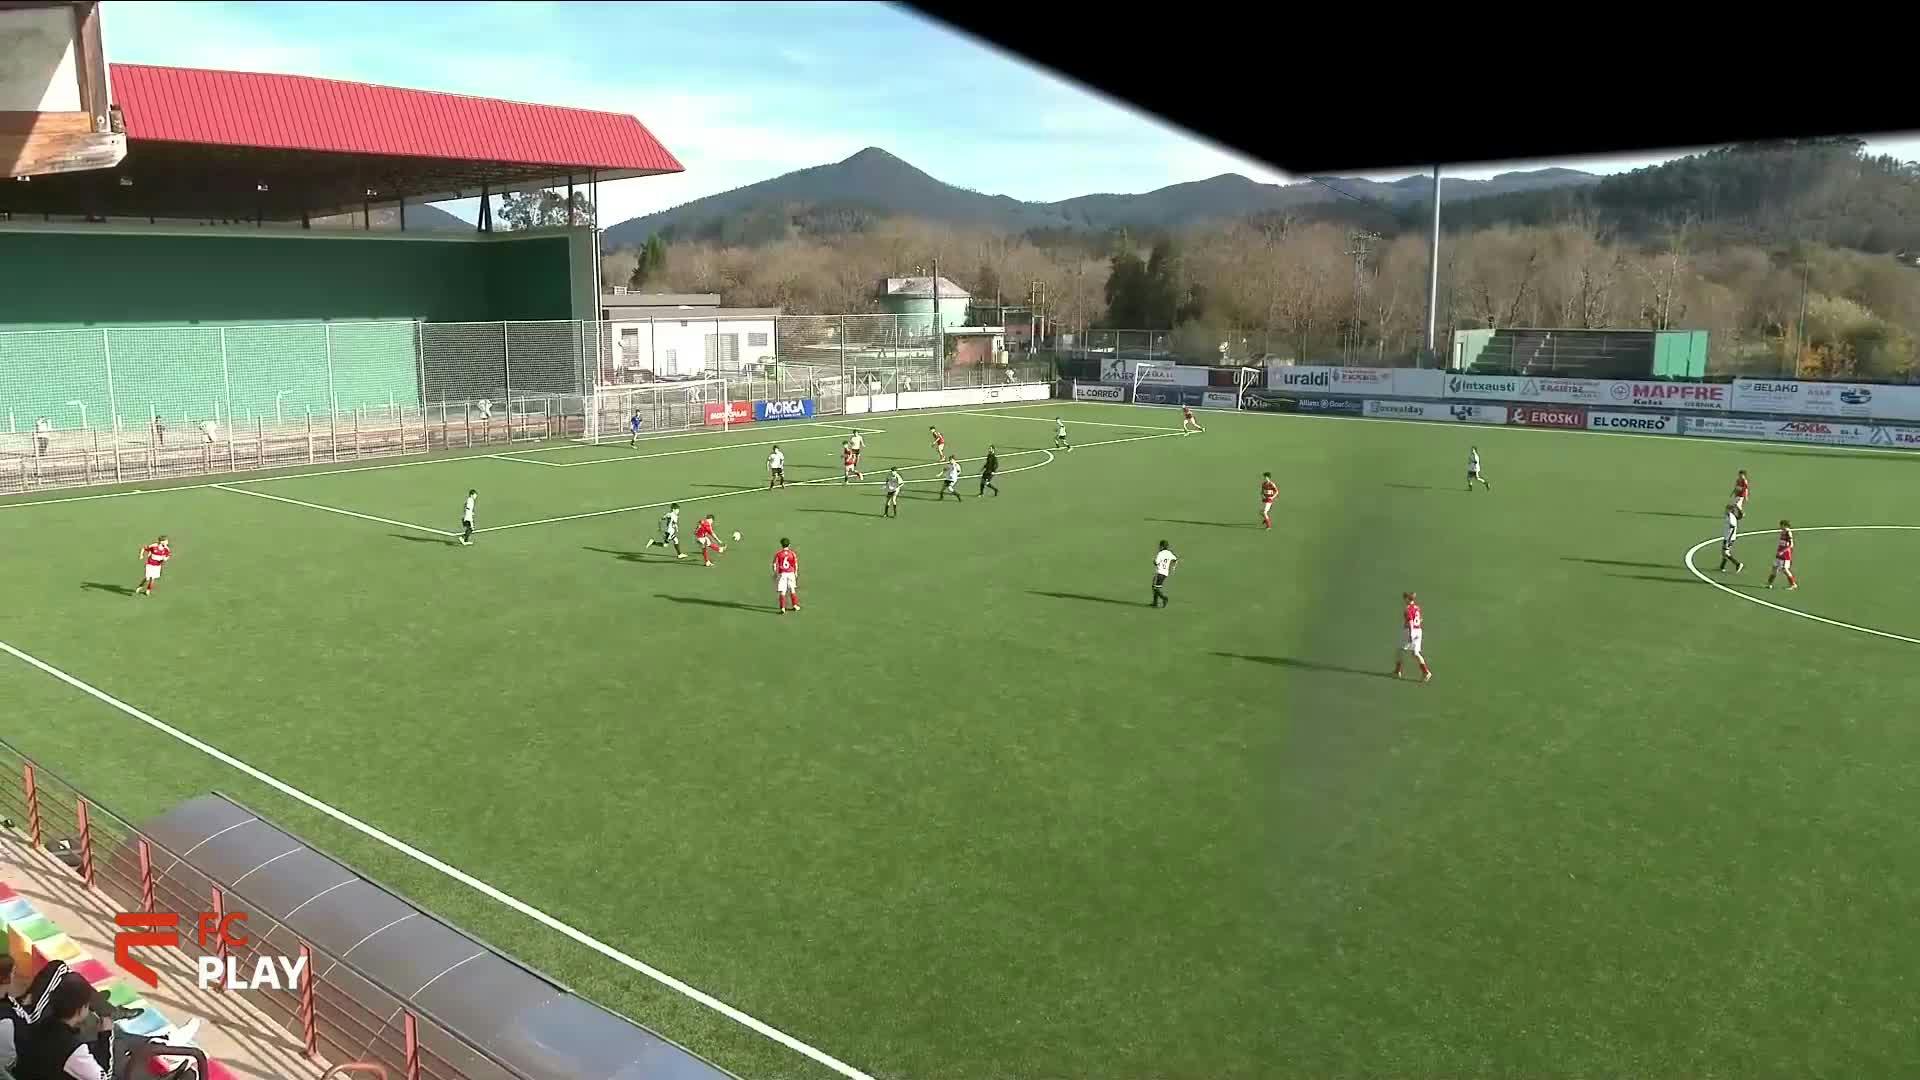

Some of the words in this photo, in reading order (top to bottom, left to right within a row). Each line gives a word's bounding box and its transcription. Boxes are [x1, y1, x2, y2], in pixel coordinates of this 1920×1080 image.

[1284, 370, 1329, 387] uraldi
[1462, 380, 1516, 393] Intxausti
[1632, 384, 1725, 401] MAPFRE
[1753, 383, 1798, 393] BELAKO
[1086, 390, 1119, 398] CORREO
[765, 401, 805, 417] MORGA
[1531, 411, 1579, 425] EROSKI
[1594, 417, 1607, 426] EL
[1611, 417, 1665, 430] CORREO
[783, 556, 790, 570] 6
